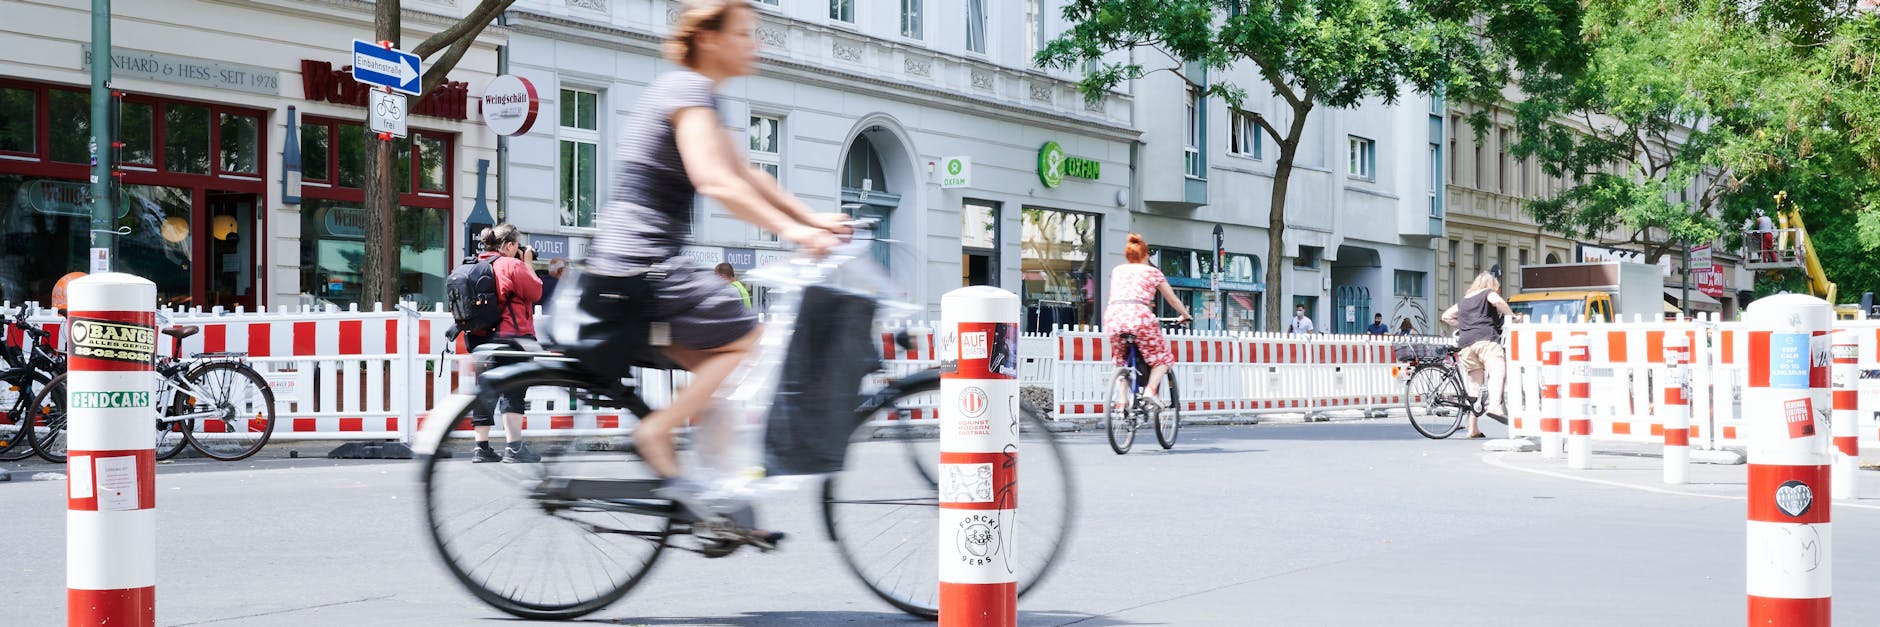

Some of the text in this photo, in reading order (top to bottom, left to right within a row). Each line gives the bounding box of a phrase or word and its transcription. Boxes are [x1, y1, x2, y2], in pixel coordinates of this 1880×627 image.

[85, 51, 159, 73] BNHARD
[162, 64, 174, 75] &
[179, 63, 211, 80] HESS
[220, 69, 246, 85] SEIT
[250, 74, 278, 89] 1978
[356, 55, 403, 77] Einbahnstraße
[485, 92, 528, 105] Weingschäft
[383, 118, 396, 131] frei
[1066, 156, 1100, 180] OXFAM
[944, 177, 966, 186] OXFAM
[534, 239, 564, 254] OUTLET
[727, 252, 751, 265] OUTLET
[90, 324, 155, 345] BANGS
[963, 334, 986, 348] AUF
[89, 339, 120, 347] ALLES
[73, 391, 147, 408] #ENDCARS
